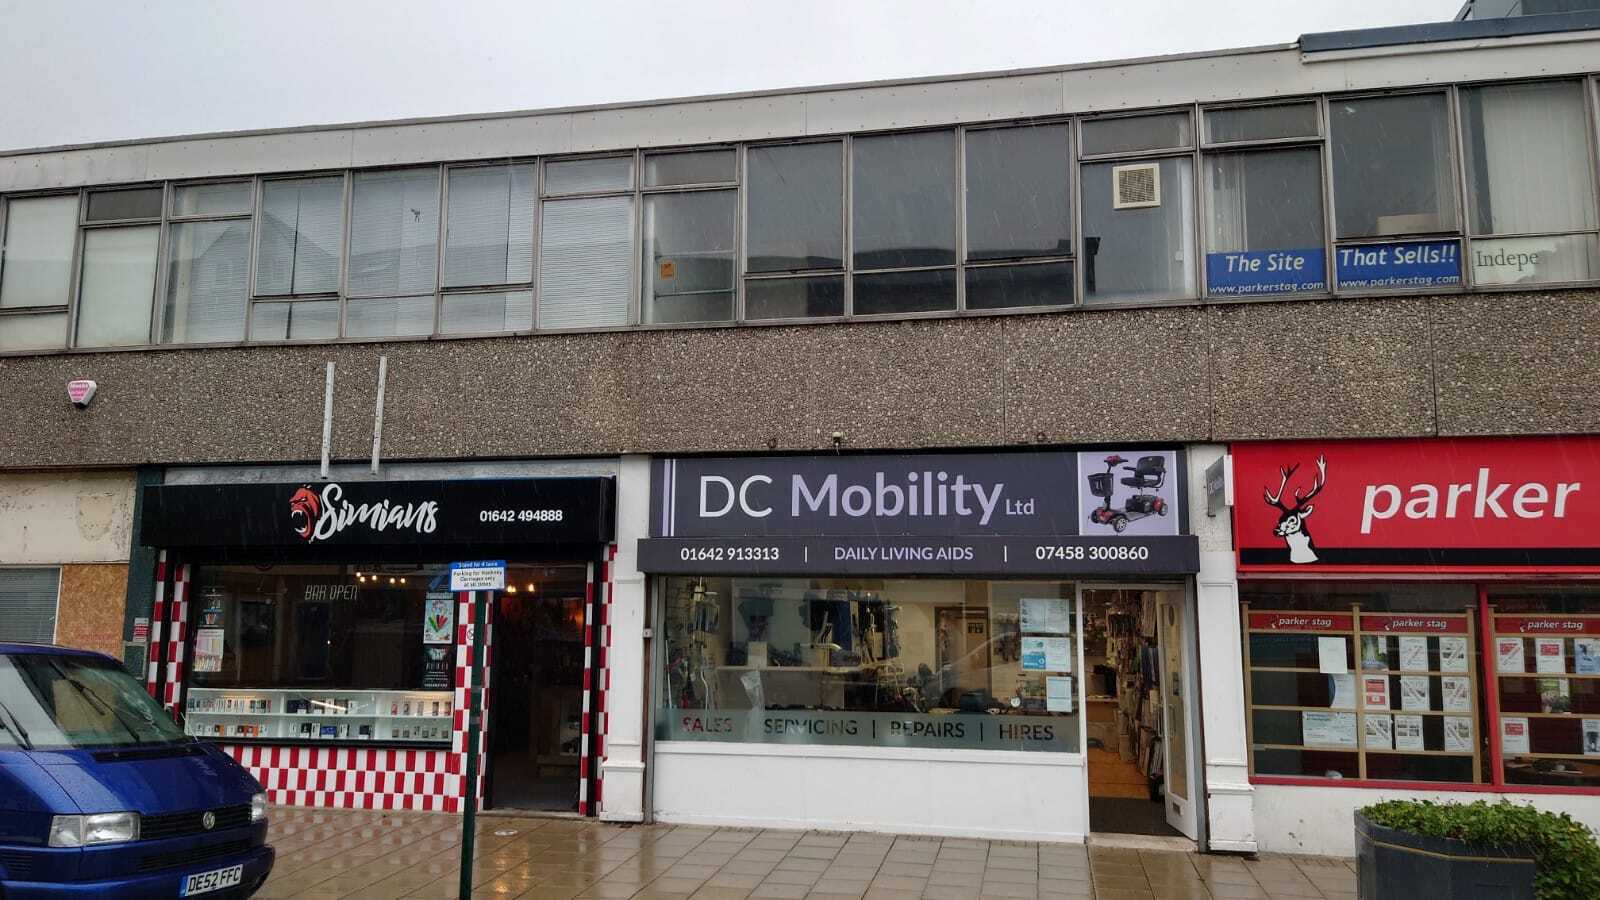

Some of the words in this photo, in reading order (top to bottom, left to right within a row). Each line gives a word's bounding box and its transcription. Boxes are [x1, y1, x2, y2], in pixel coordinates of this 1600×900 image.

[1226, 255, 1261, 272] The
[1267, 253, 1305, 271] Site
[1341, 247, 1386, 266] That
[1393, 245, 1456, 265] Sells!!
[1209, 282, 1324, 294] www.parkerstag.com
[1340, 275, 1459, 288] www.parkerstag.com
[700, 475, 773, 518] DC
[791, 471, 1004, 525] Mobility
[1006, 499, 1035, 515] Ltd
[1360, 468, 1580, 534] parker
[312, 483, 439, 541] Simians
[479, 510, 515, 522] 01642
[518, 510, 563, 521] 494888
[680, 548, 724, 561] 01642
[727, 547, 780, 560] 913313
[834, 547, 878, 560] DAILY
[881, 547, 933, 560] LIVING
[936, 547, 974, 560] AIDS
[1035, 546, 1084, 560] 07458
[1088, 546, 1149, 560] 300860
[305, 585, 326, 600] BAR
[329, 584, 357, 600] OPEN
[1278, 617, 1310, 626] parker
[1312, 618, 1332, 627] stag
[1392, 619, 1424, 628] parker
[1426, 620, 1447, 629] stag
[1527, 620, 1559, 630] parker
[1561, 621, 1584, 630] stag
[682, 717, 733, 732] SALES
[764, 718, 858, 735] SERVICING
[890, 720, 965, 738] REPAIRS
[1000, 724, 1054, 740] HIRES
[188, 871, 219, 892] DE52
